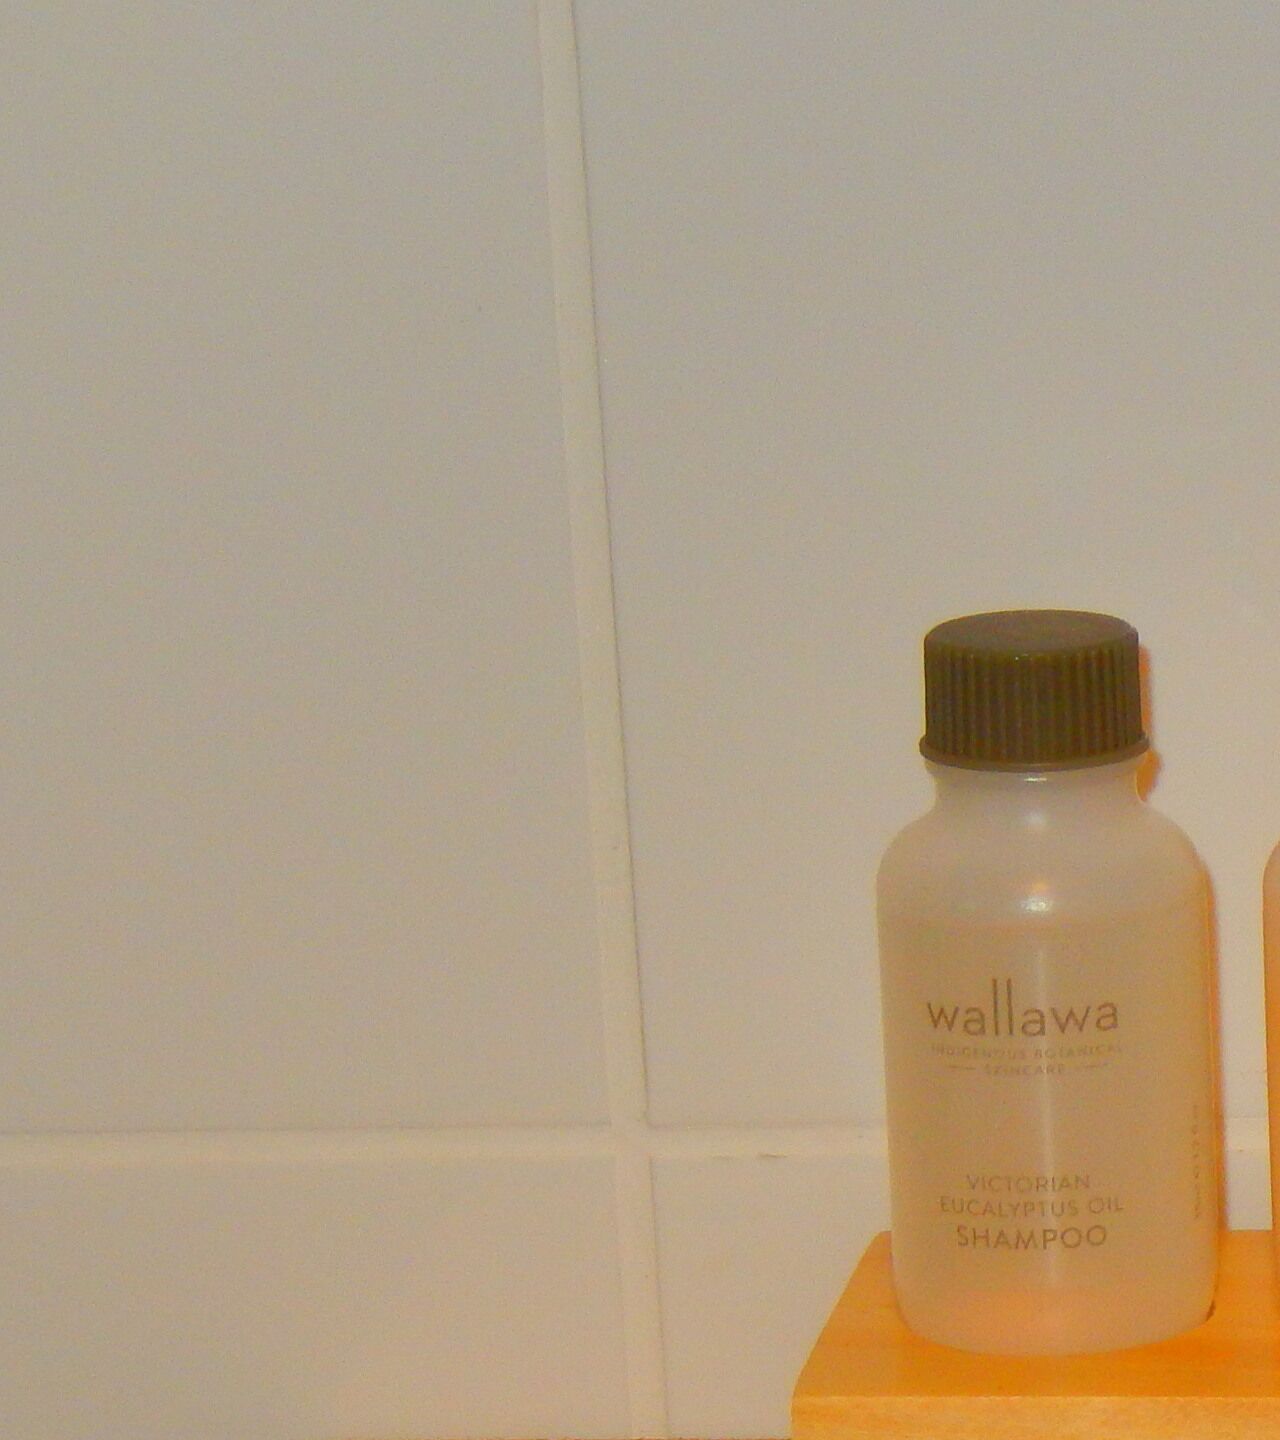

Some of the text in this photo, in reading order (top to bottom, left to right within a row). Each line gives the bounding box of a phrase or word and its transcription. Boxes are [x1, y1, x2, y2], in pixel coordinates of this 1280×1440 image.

[927, 978, 1119, 1037] wallawa
[965, 1173, 1091, 1193] VICTORIAN
[940, 1195, 1125, 1218] EUCALYPTUS OIL
[956, 1224, 1108, 1251] SHAMPOO
